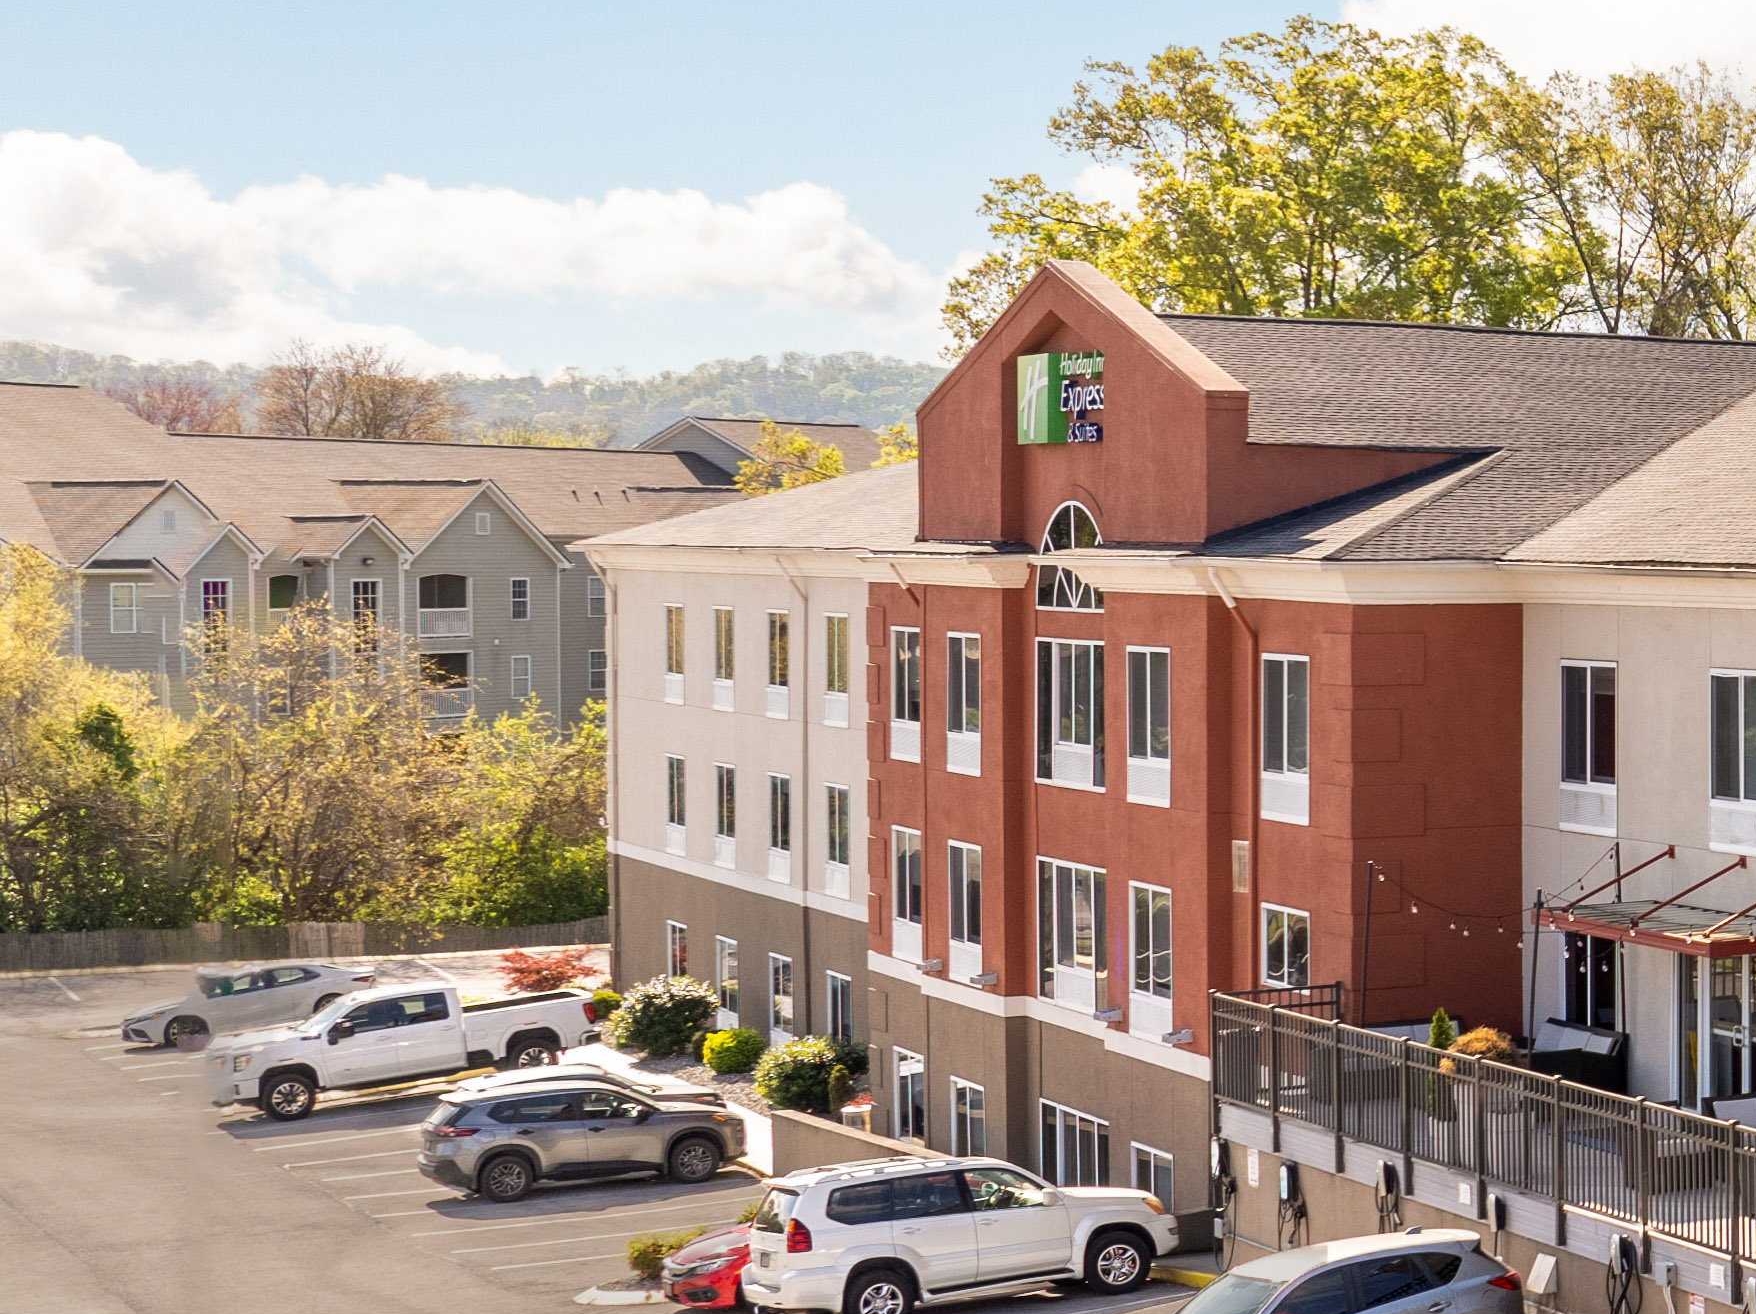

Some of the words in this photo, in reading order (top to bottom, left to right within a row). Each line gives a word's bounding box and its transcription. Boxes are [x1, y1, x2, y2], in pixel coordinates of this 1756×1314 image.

[1060, 351, 1093, 379] Holiday
[1060, 380, 1104, 420] Express
[1075, 422, 1098, 442] Suites
